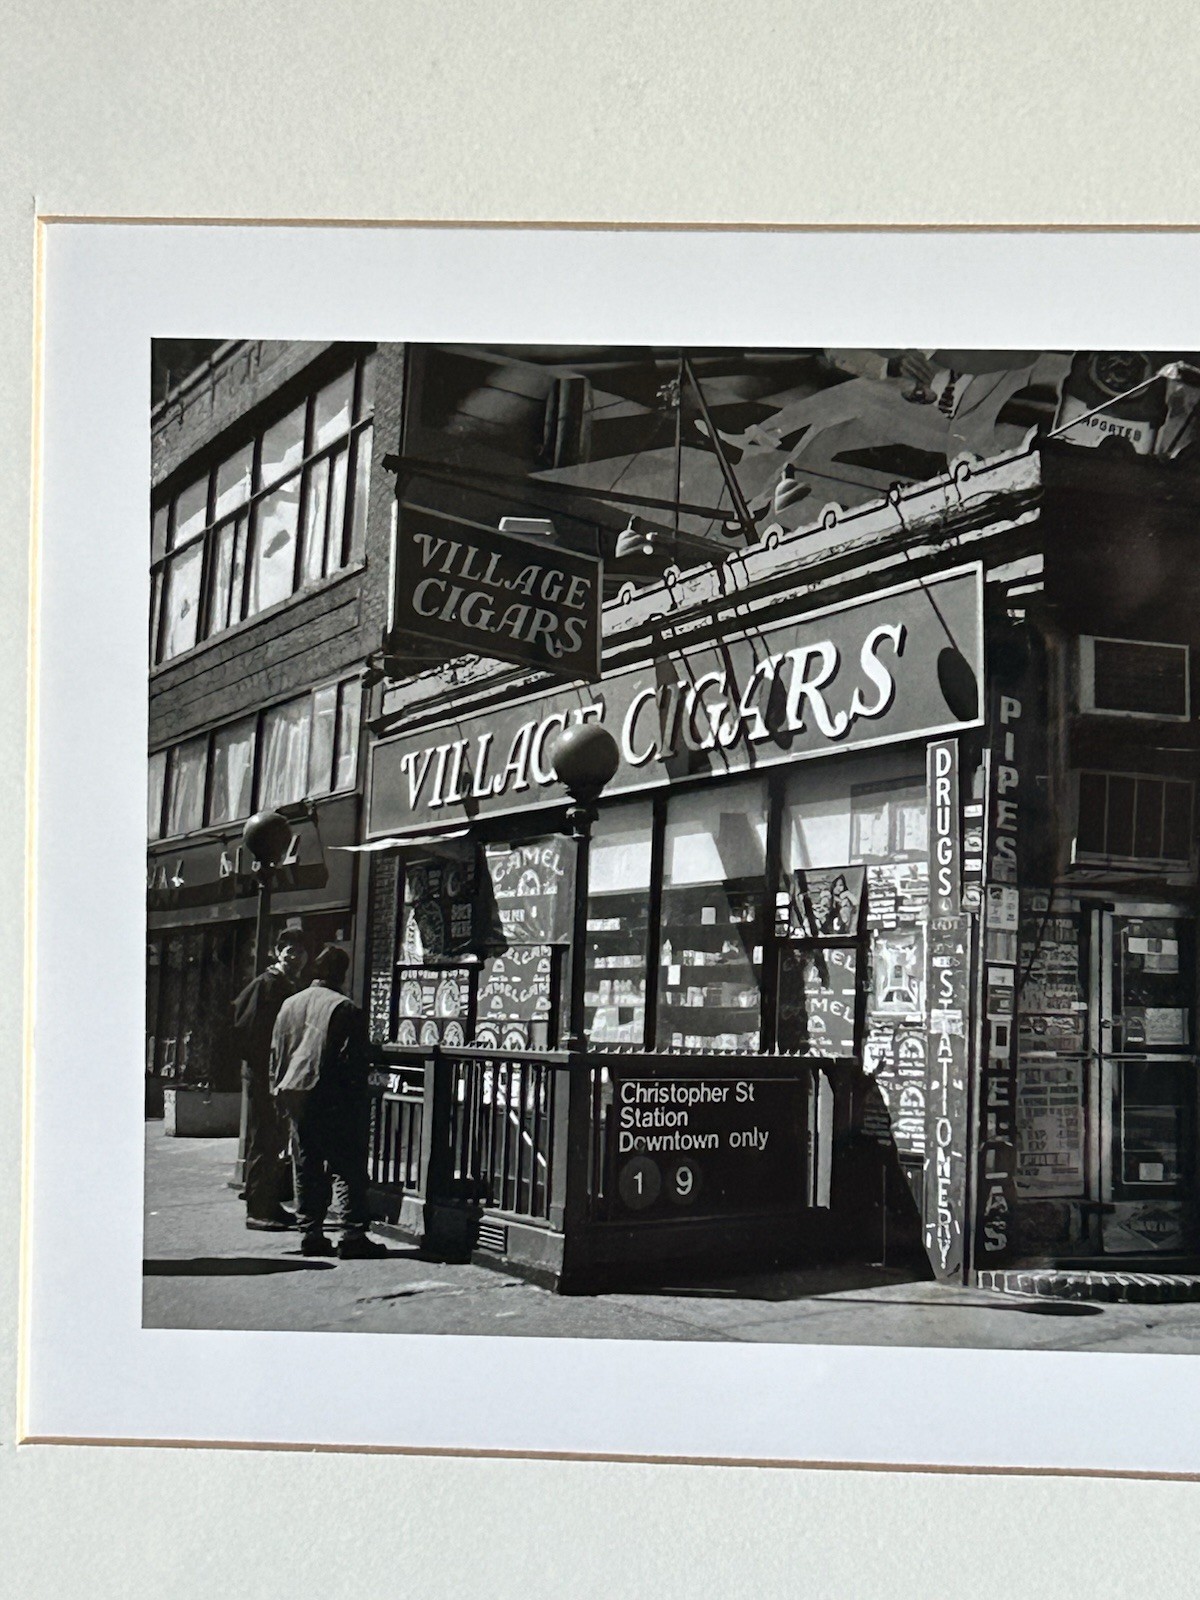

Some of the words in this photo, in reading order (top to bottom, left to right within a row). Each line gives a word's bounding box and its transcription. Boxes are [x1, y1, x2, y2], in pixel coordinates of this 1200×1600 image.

[412, 532, 592, 610] VILLAGE
[412, 577, 588, 659] CIGARS
[622, 623, 904, 766] CIGARS
[935, 747, 952, 896] DRUGS
[492, 847, 565, 883] CAMEL
[620, 1081, 730, 1107] Christopher
[735, 1081, 755, 1102] St
[620, 1106, 689, 1129] Station
[619, 1130, 719, 1153] Downtown
[729, 1126, 769, 1151] only
[633, 1171, 644, 1195] 1
[675, 1166, 694, 1196] 9
